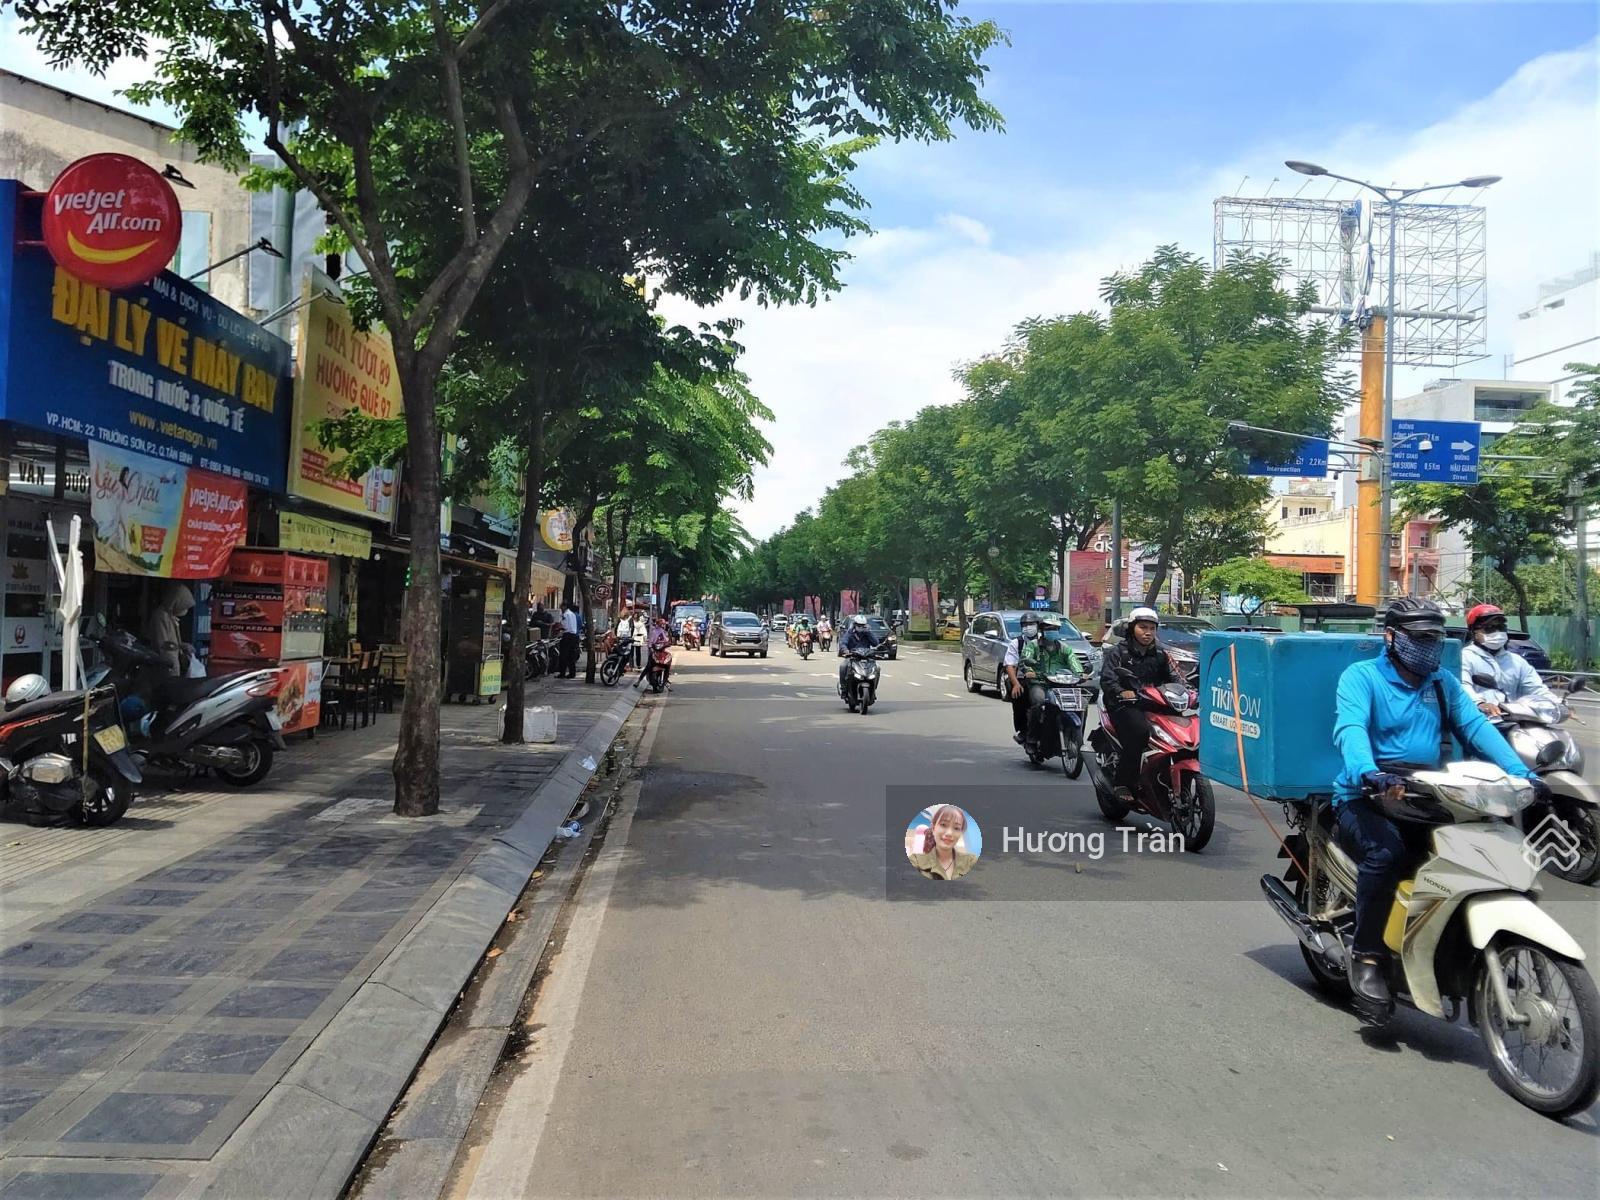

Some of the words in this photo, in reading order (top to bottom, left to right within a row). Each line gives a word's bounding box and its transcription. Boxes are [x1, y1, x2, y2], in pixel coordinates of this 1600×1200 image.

[114, 297, 152, 356] LÝ
[241, 363, 278, 414] BAY
[325, 314, 347, 358] BIA
[379, 359, 391, 389] 89
[107, 359, 154, 399] TRONG
[191, 394, 201, 417] &
[84, 423, 95, 437] 22
[1423, 876, 1452, 895] HONDA
